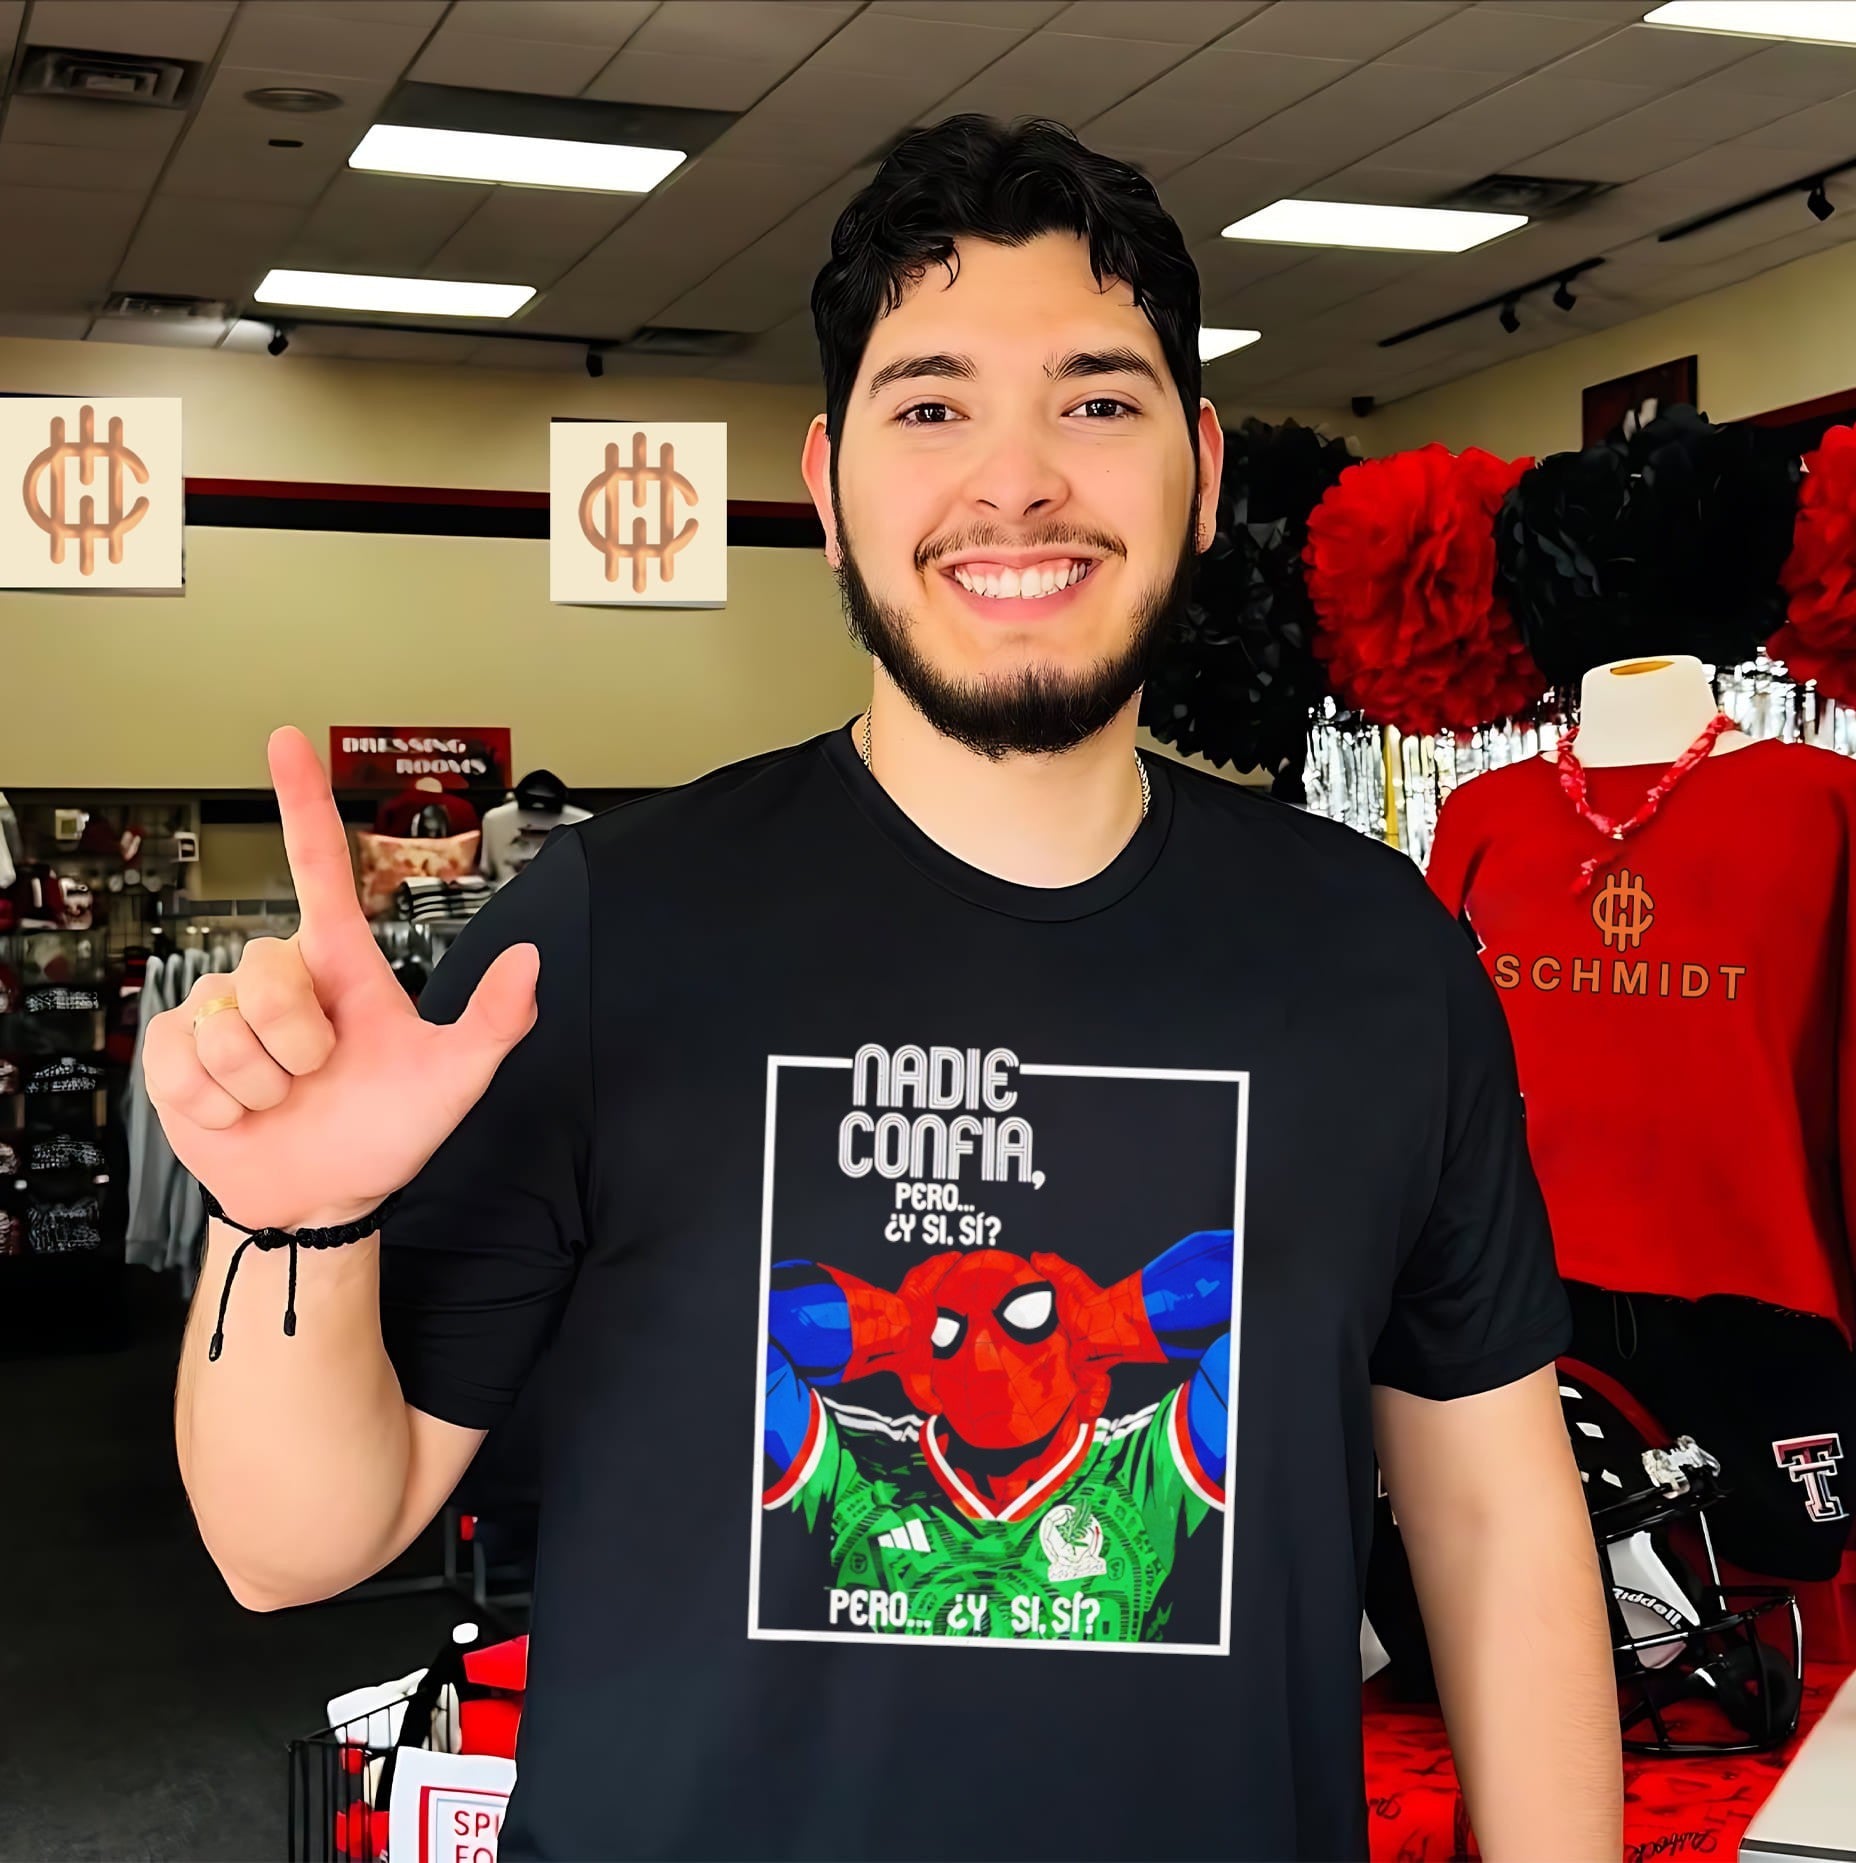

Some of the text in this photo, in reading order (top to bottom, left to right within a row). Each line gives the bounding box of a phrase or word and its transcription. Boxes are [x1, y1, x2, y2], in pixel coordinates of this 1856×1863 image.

[1494, 953, 1747, 1000] SCHMIDT
[852, 1042, 1020, 1113] NADIE
[838, 1110, 1046, 1191] CONFIA,
[895, 1181, 976, 1213] PERO...
[884, 1212, 917, 1243] ¿Y
[958, 1211, 1003, 1247] SÍ?
[829, 1589, 932, 1629] PERO...
[947, 1593, 988, 1632] ¿Y
[1051, 1591, 1101, 1635] SÍ?
